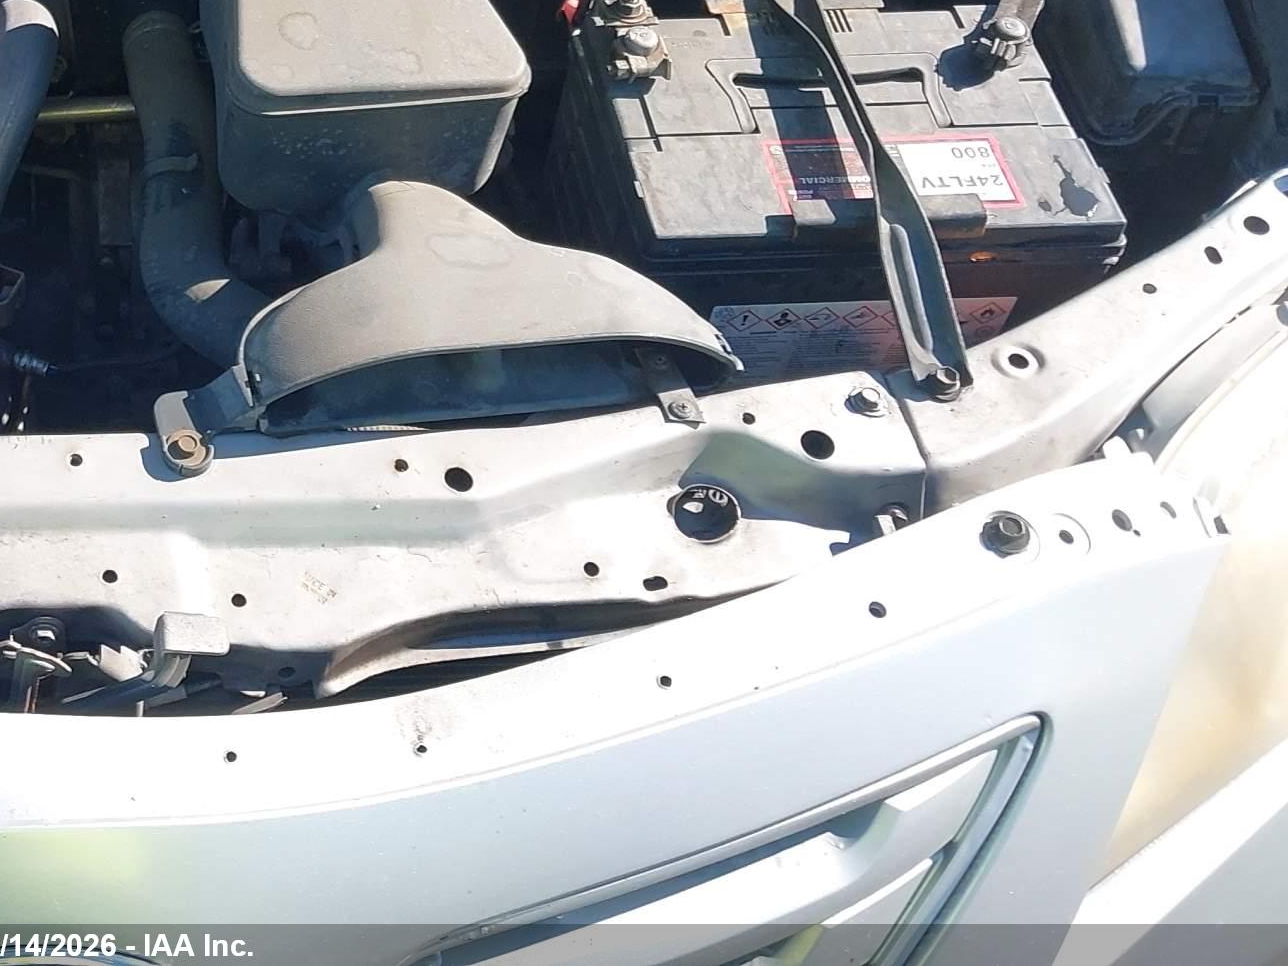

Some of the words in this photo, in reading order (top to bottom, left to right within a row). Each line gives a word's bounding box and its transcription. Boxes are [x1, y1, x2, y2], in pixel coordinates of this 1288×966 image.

[951, 146, 990, 159] 800
[798, 175, 871, 185] OMMERCIAL
[921, 174, 1004, 189] 24FLTV
